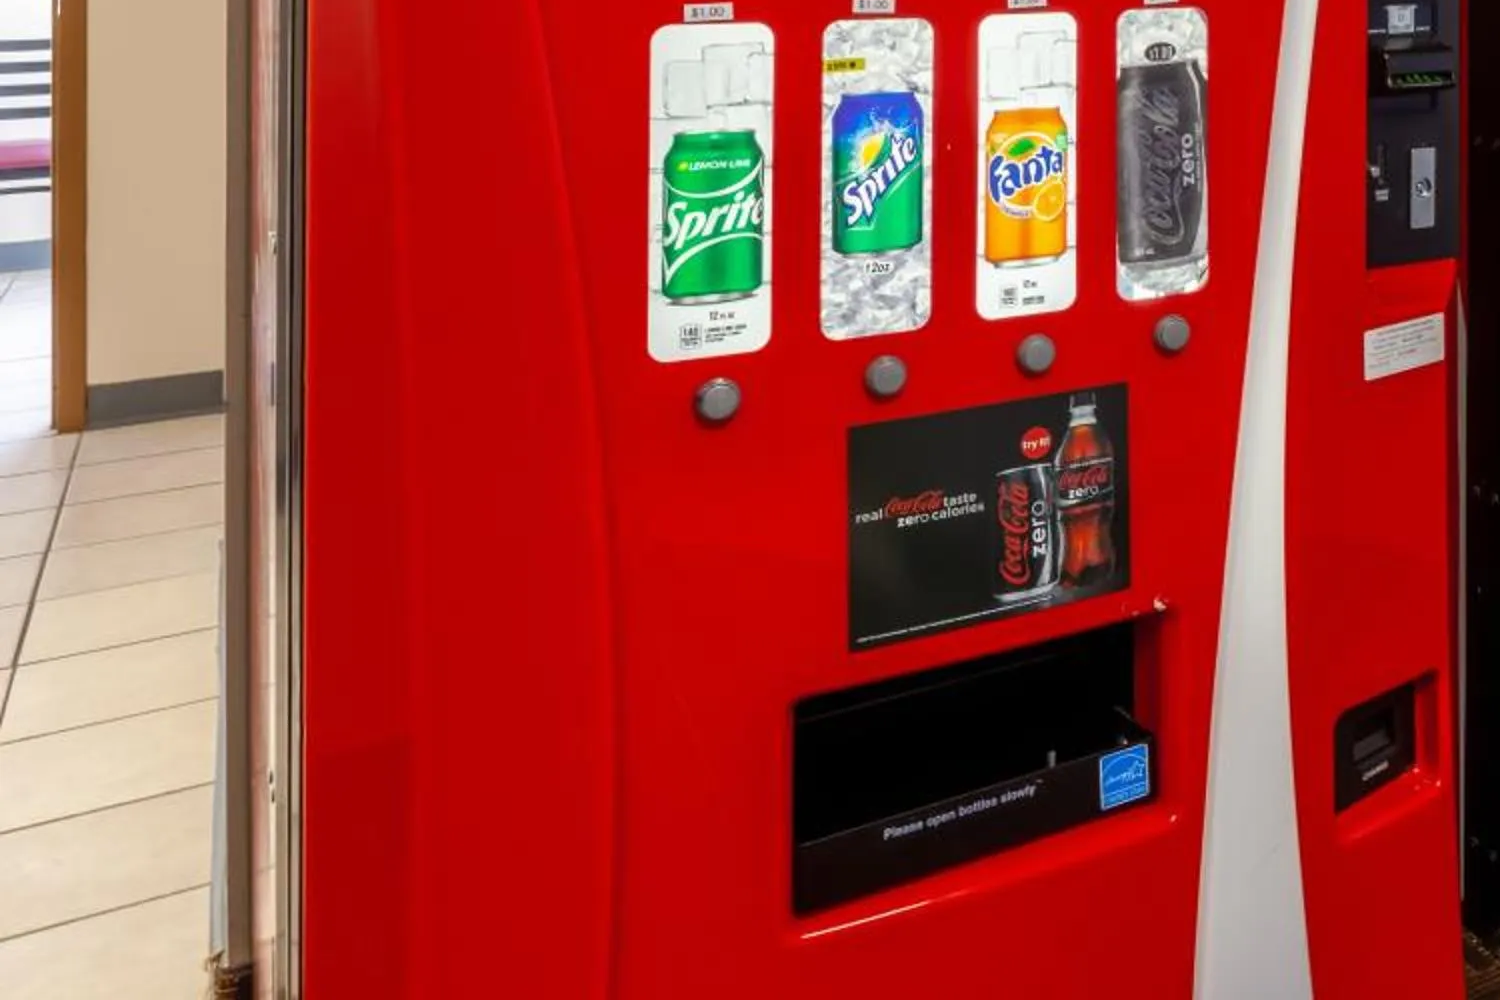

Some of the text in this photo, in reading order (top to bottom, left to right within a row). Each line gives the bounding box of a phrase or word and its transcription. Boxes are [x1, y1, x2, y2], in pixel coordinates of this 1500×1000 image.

[691, 6, 725, 18] $1.00
[858, 0, 889, 10] $1.00
[1182, 132, 1196, 187] zero
[843, 136, 917, 226] Sprite
[866, 261, 890, 273] 12oz
[1022, 438, 1037, 450] try
[1068, 485, 1099, 499] zero
[856, 508, 883, 524] real
[943, 493, 977, 508] taste
[897, 502, 985, 528] zero calories
[1031, 500, 1047, 558] zero
[883, 785, 1036, 841] Please open bottles slowly
